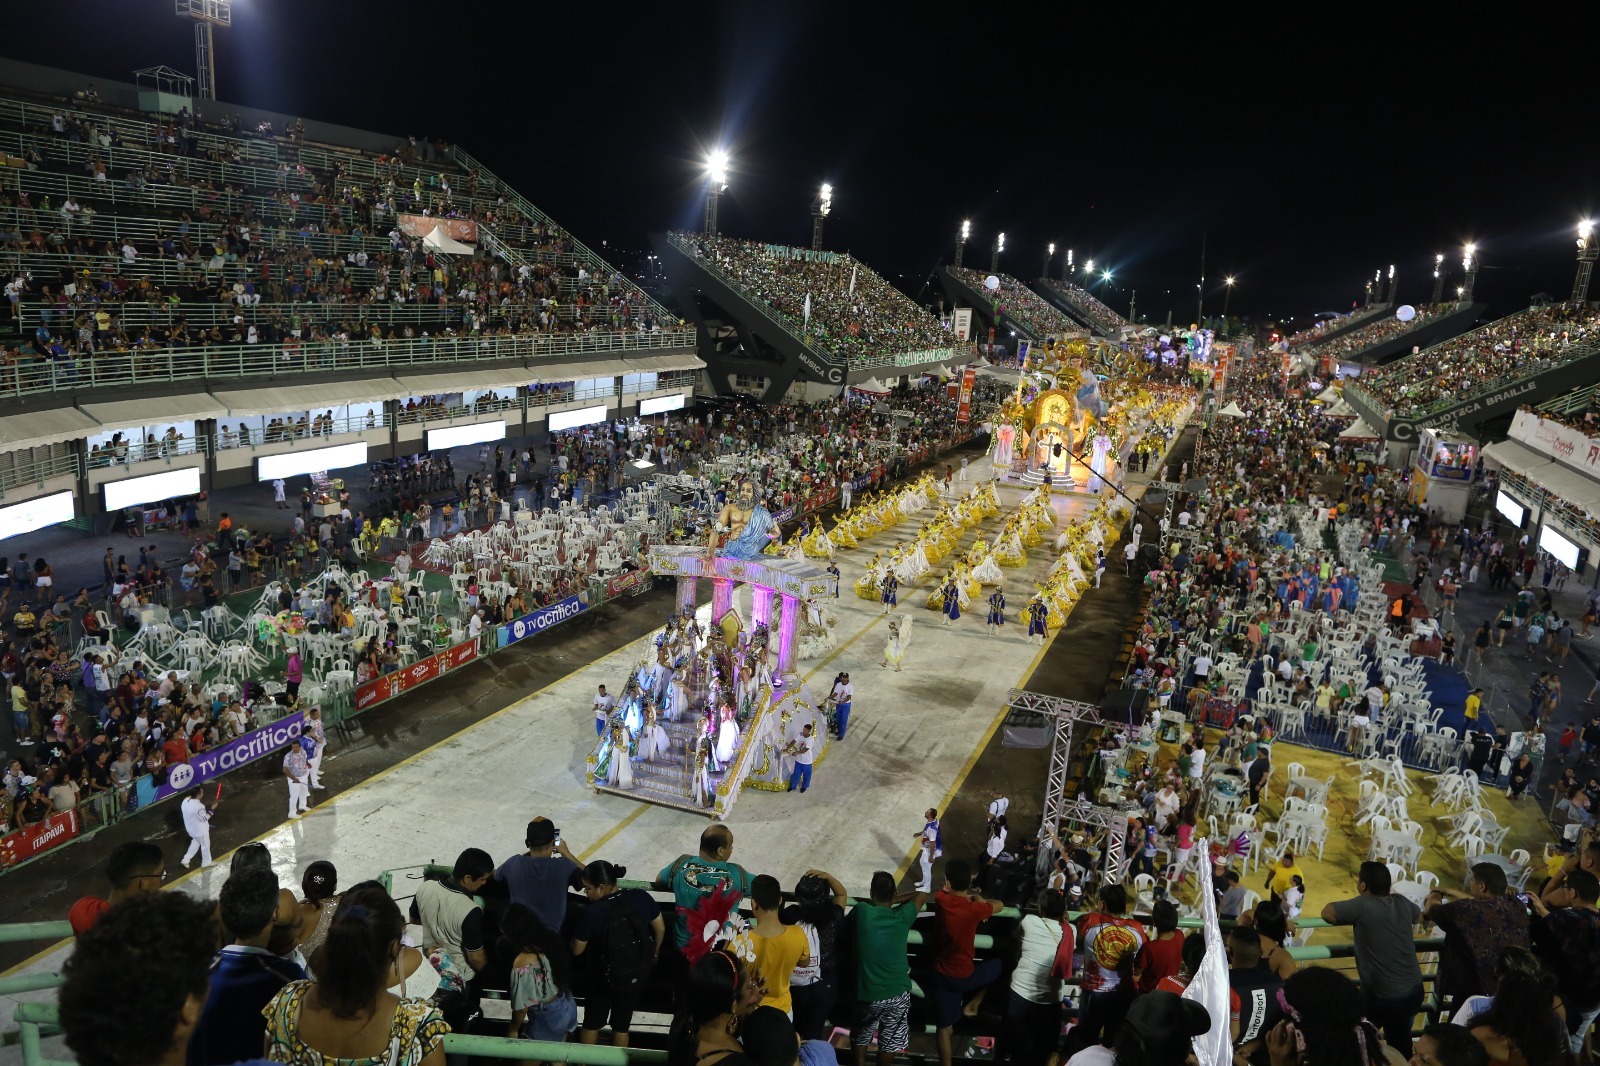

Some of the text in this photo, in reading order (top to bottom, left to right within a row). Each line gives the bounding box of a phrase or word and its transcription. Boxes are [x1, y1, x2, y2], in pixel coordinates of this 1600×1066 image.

[828, 368, 843, 383] G
[1414, 381, 1537, 433] BIBLIOTECA BRAILLE
[1393, 422, 1413, 440] C
[527, 619, 537, 631] TV
[199, 720, 302, 776] TV acrítica
[32, 823, 65, 850] ITAIPAVA
